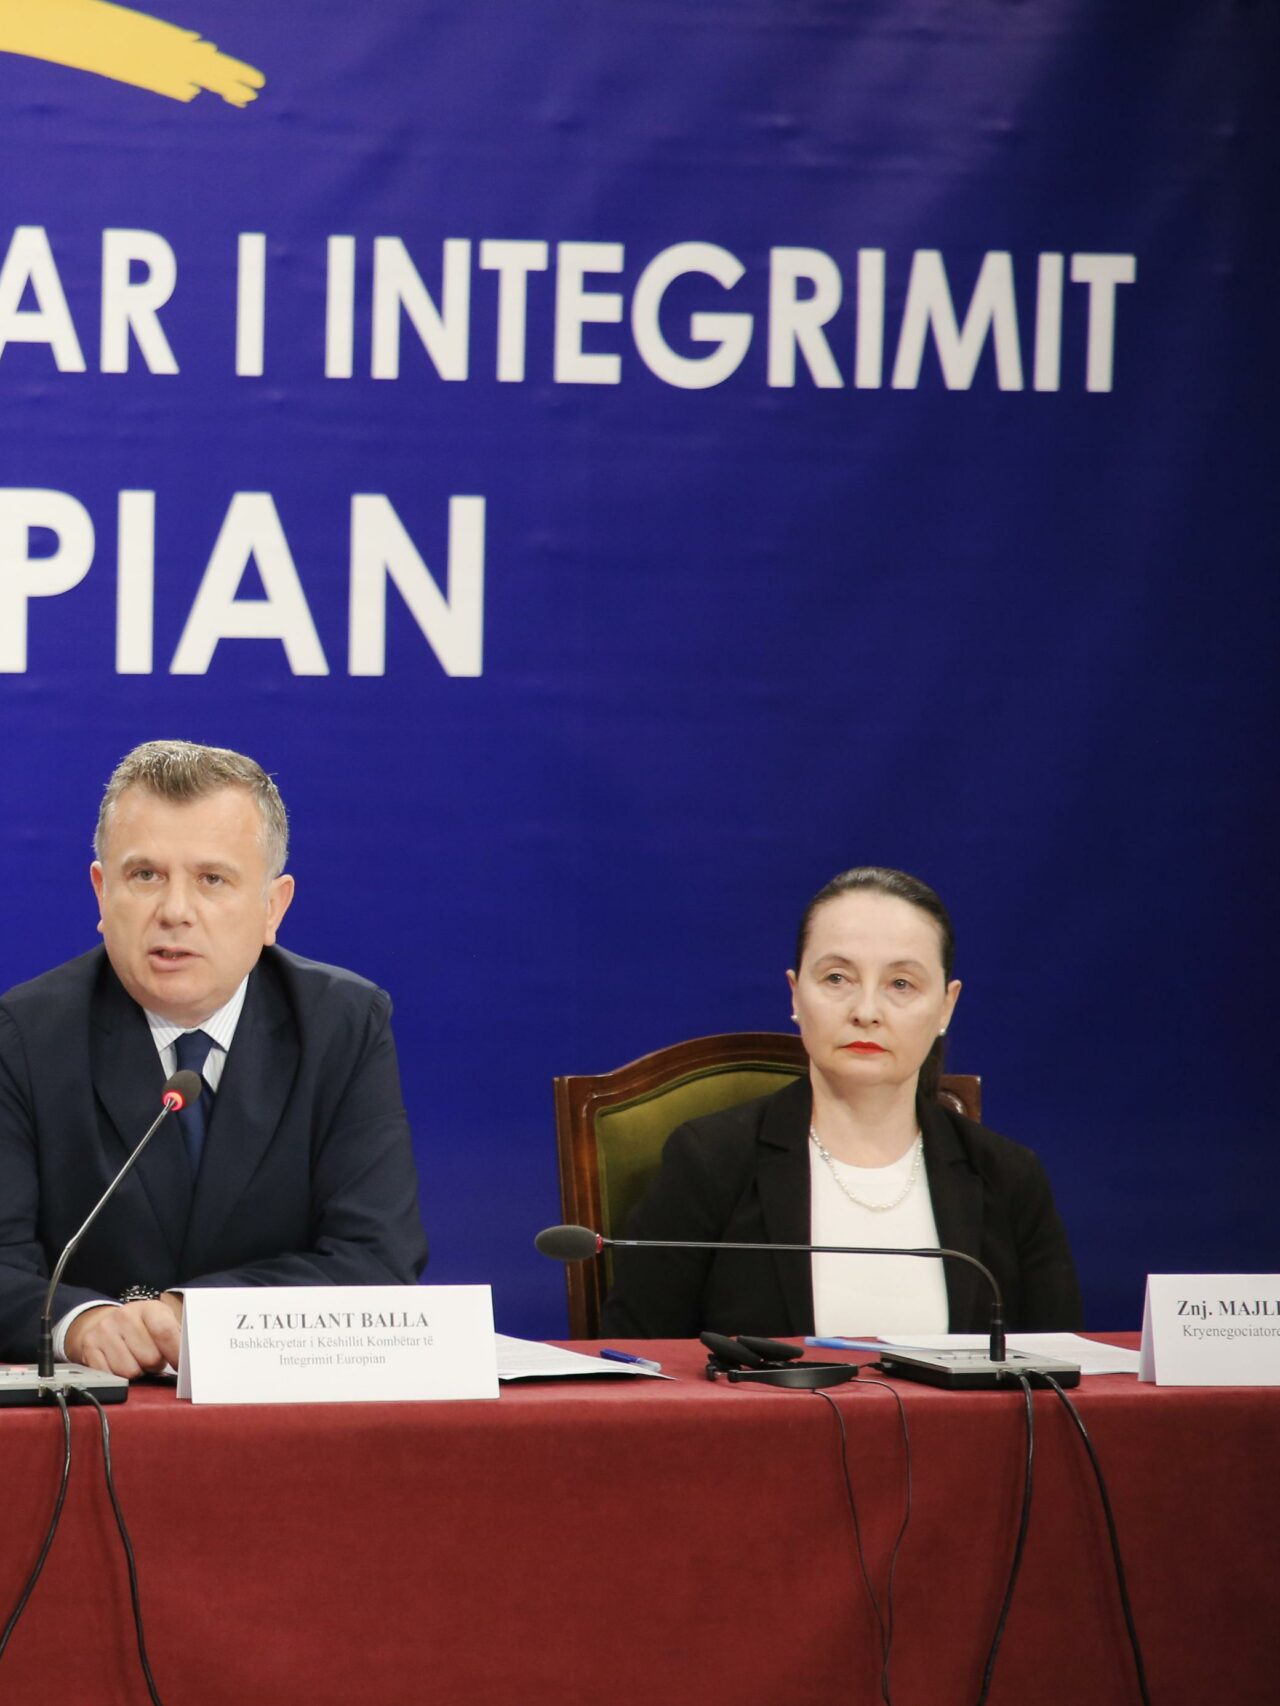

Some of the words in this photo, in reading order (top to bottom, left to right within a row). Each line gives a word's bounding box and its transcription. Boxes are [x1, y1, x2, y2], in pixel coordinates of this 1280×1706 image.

[236, 233, 265, 376] I
[326, 236, 1134, 391] INTEGRIMIT
[1177, 1300, 1213, 1320] Znj.
[236, 1313, 254, 1330] Z.
[258, 1312, 355, 1329] TAULANT
[361, 1311, 429, 1328] BALLA
[279, 1354, 333, 1368] Integrimit
[336, 1353, 386, 1367] Europian
